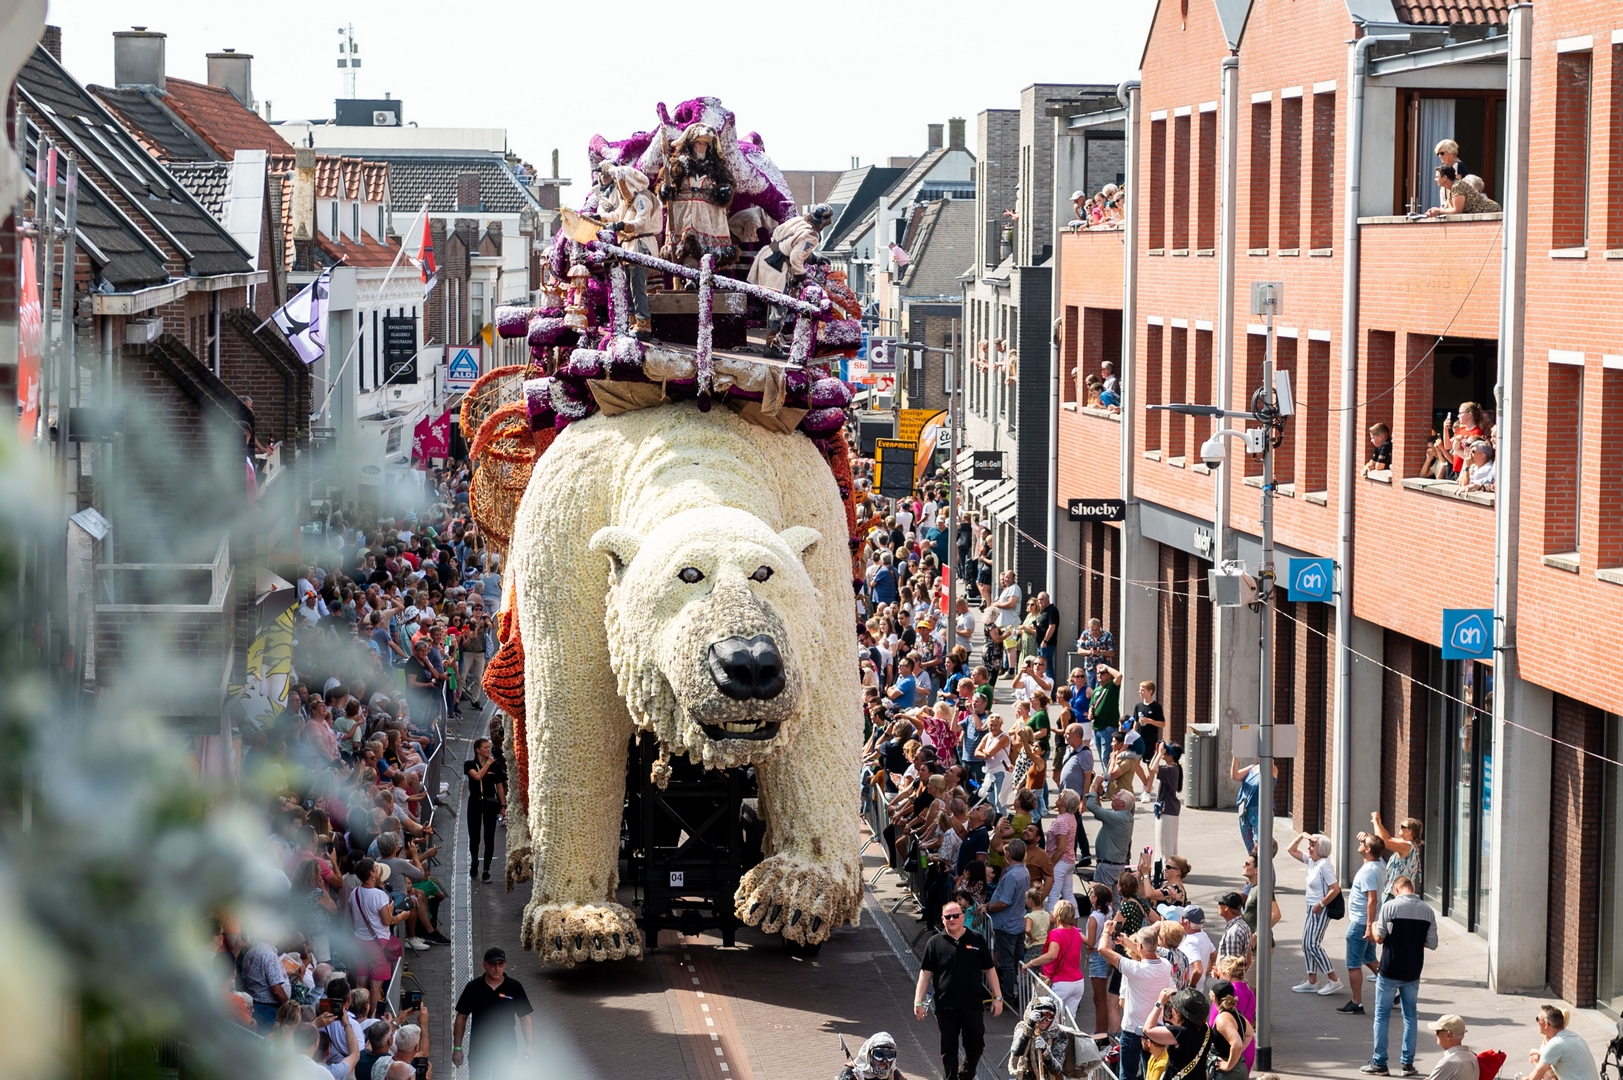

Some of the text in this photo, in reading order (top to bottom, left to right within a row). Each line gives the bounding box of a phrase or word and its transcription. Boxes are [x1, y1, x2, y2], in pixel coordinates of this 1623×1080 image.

[878, 440, 916, 449] Evenement
[1071, 502, 1120, 518] shoeby
[671, 873, 682, 881] 04
